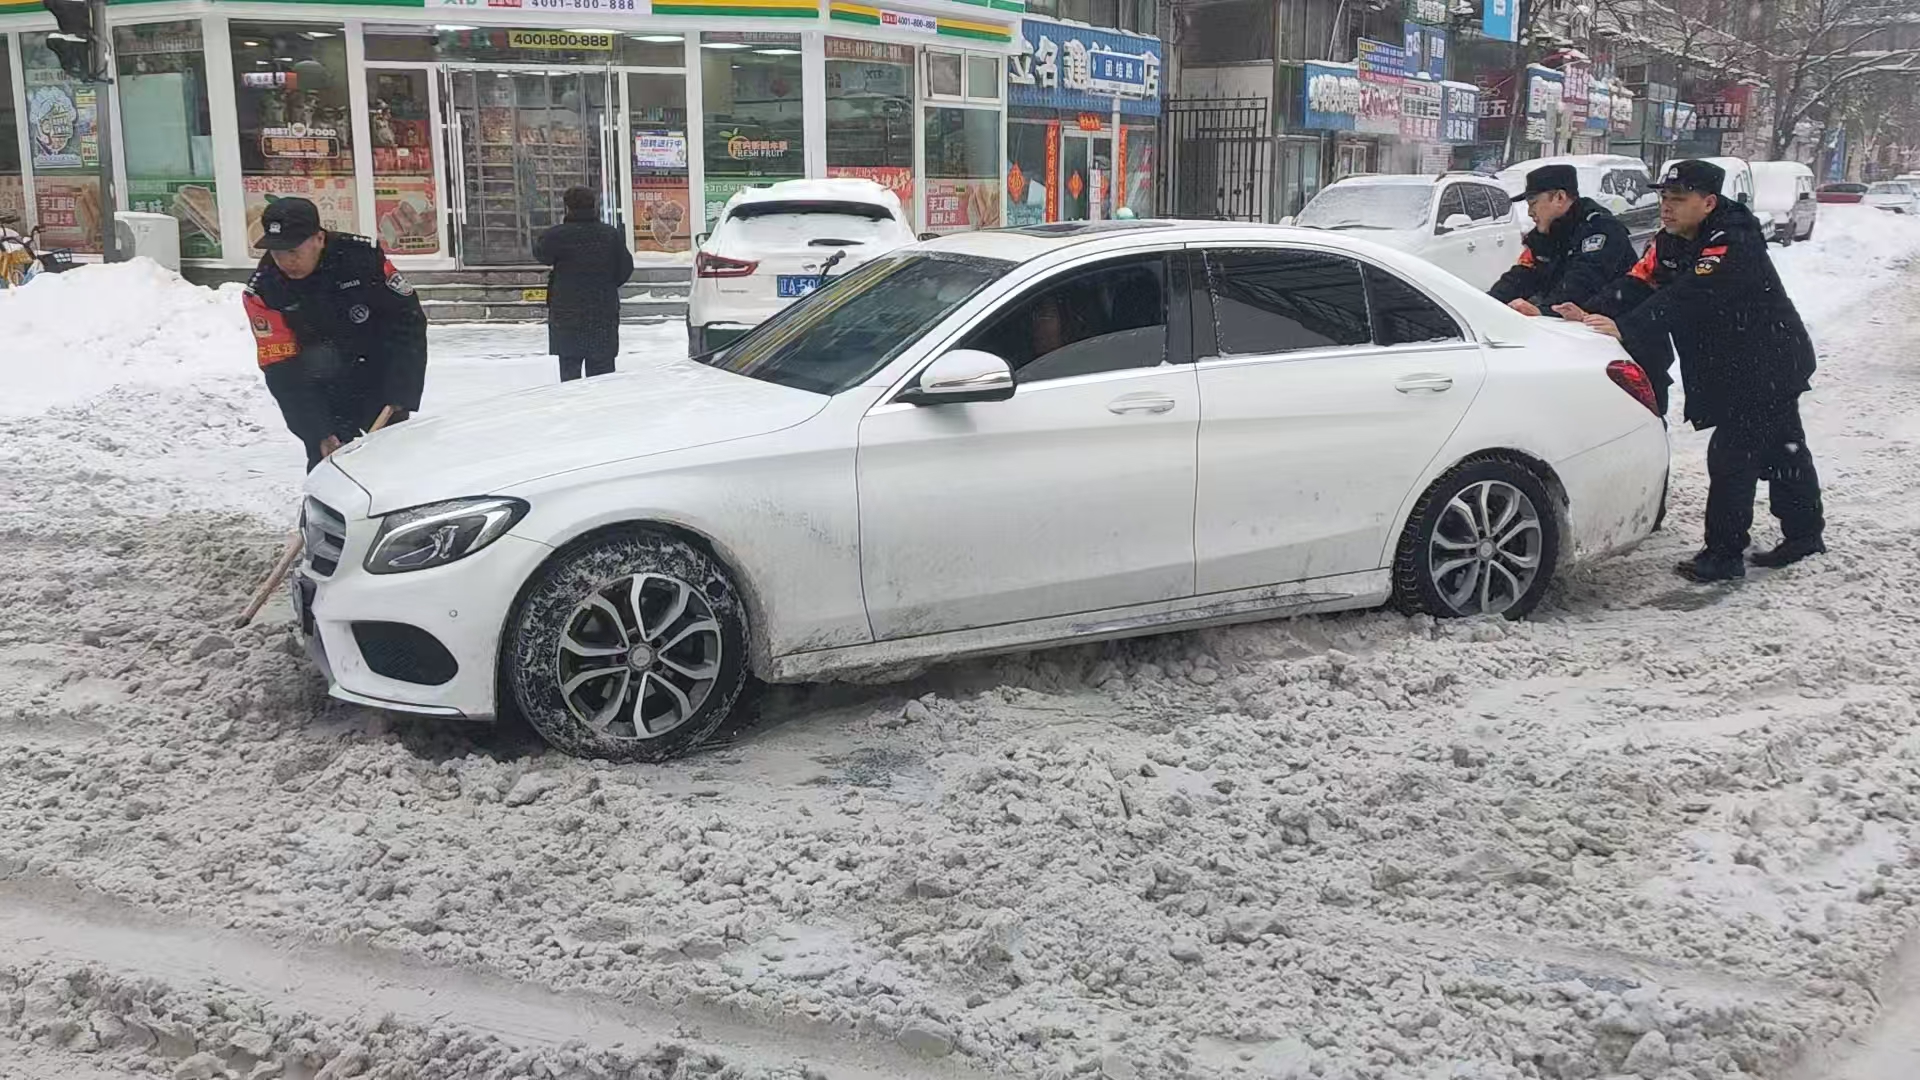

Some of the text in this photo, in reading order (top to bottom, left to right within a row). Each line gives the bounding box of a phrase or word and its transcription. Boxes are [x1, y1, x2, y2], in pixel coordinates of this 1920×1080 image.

[513, 34, 609, 47] 4001-800-888
[1105, 59, 1133, 79] 团结路
[307, 129, 336, 137] FOOD
[733, 149, 784, 158] FRESH FRUIT
